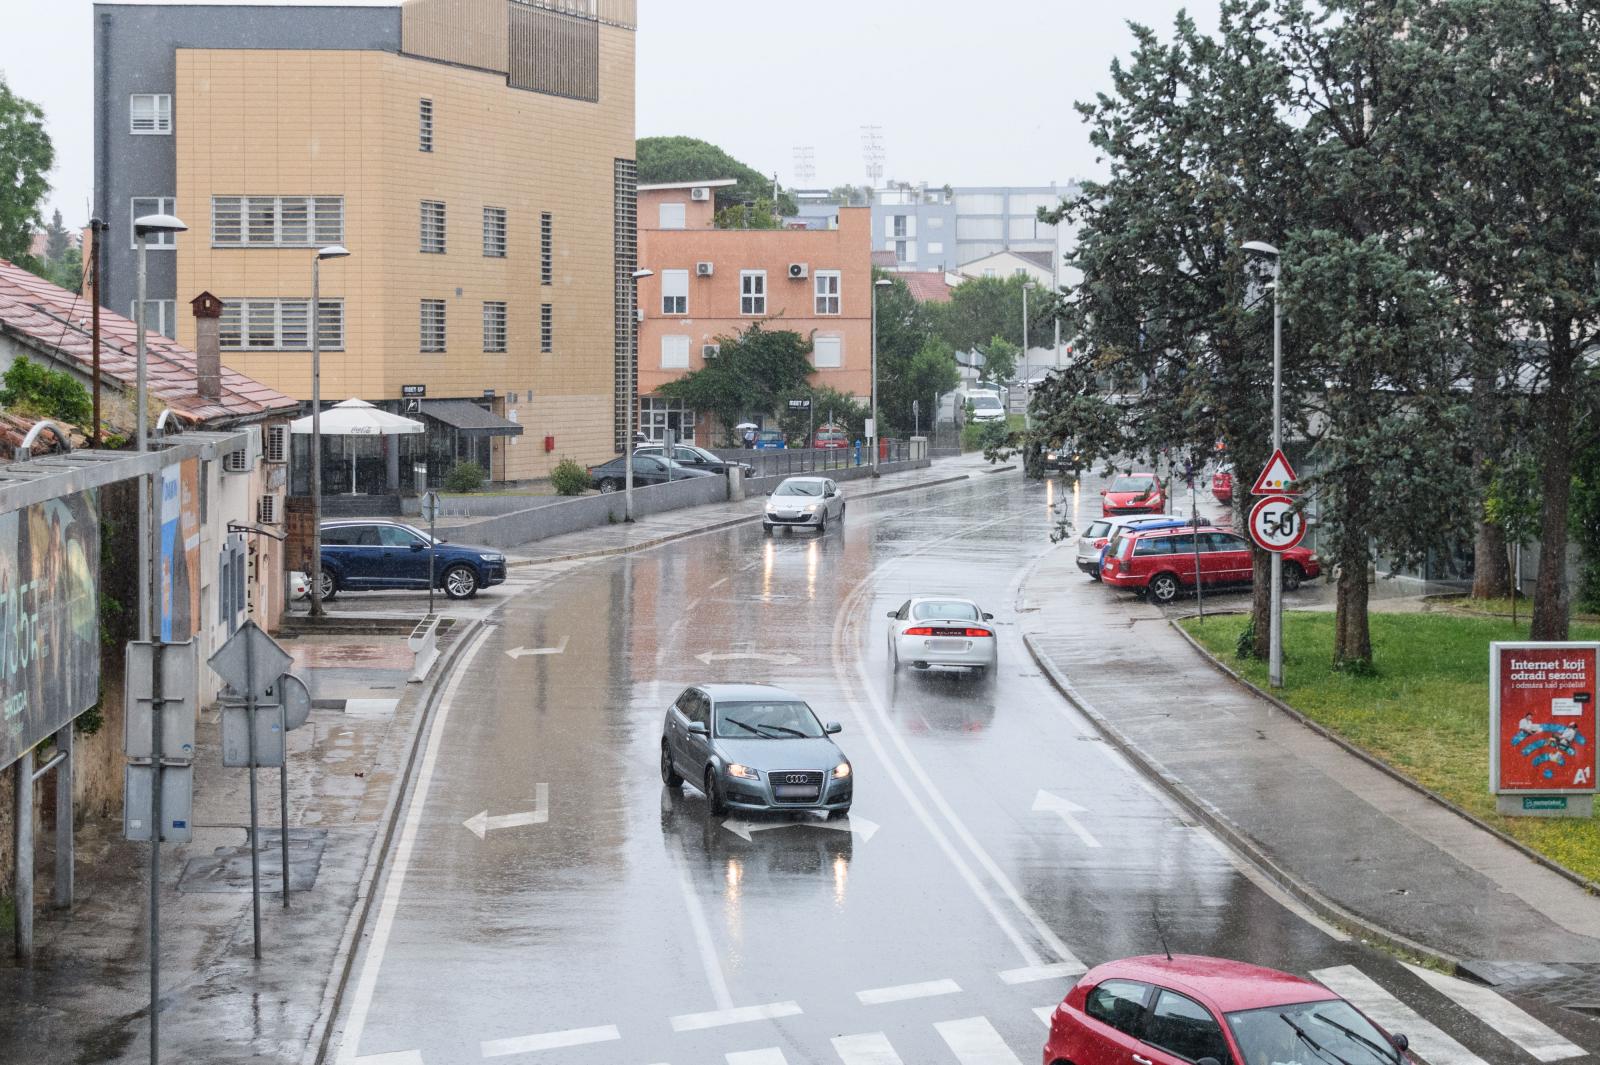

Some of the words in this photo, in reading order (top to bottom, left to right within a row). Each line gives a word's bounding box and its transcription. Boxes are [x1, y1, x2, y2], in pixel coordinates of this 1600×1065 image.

[1263, 511, 1293, 537] 50
[1511, 659, 1559, 670] Internet
[1562, 659, 1585, 672] koji
[1511, 671, 1546, 680] odradi
[1548, 672, 1586, 680] sezonu
[1573, 767, 1590, 784] A1
